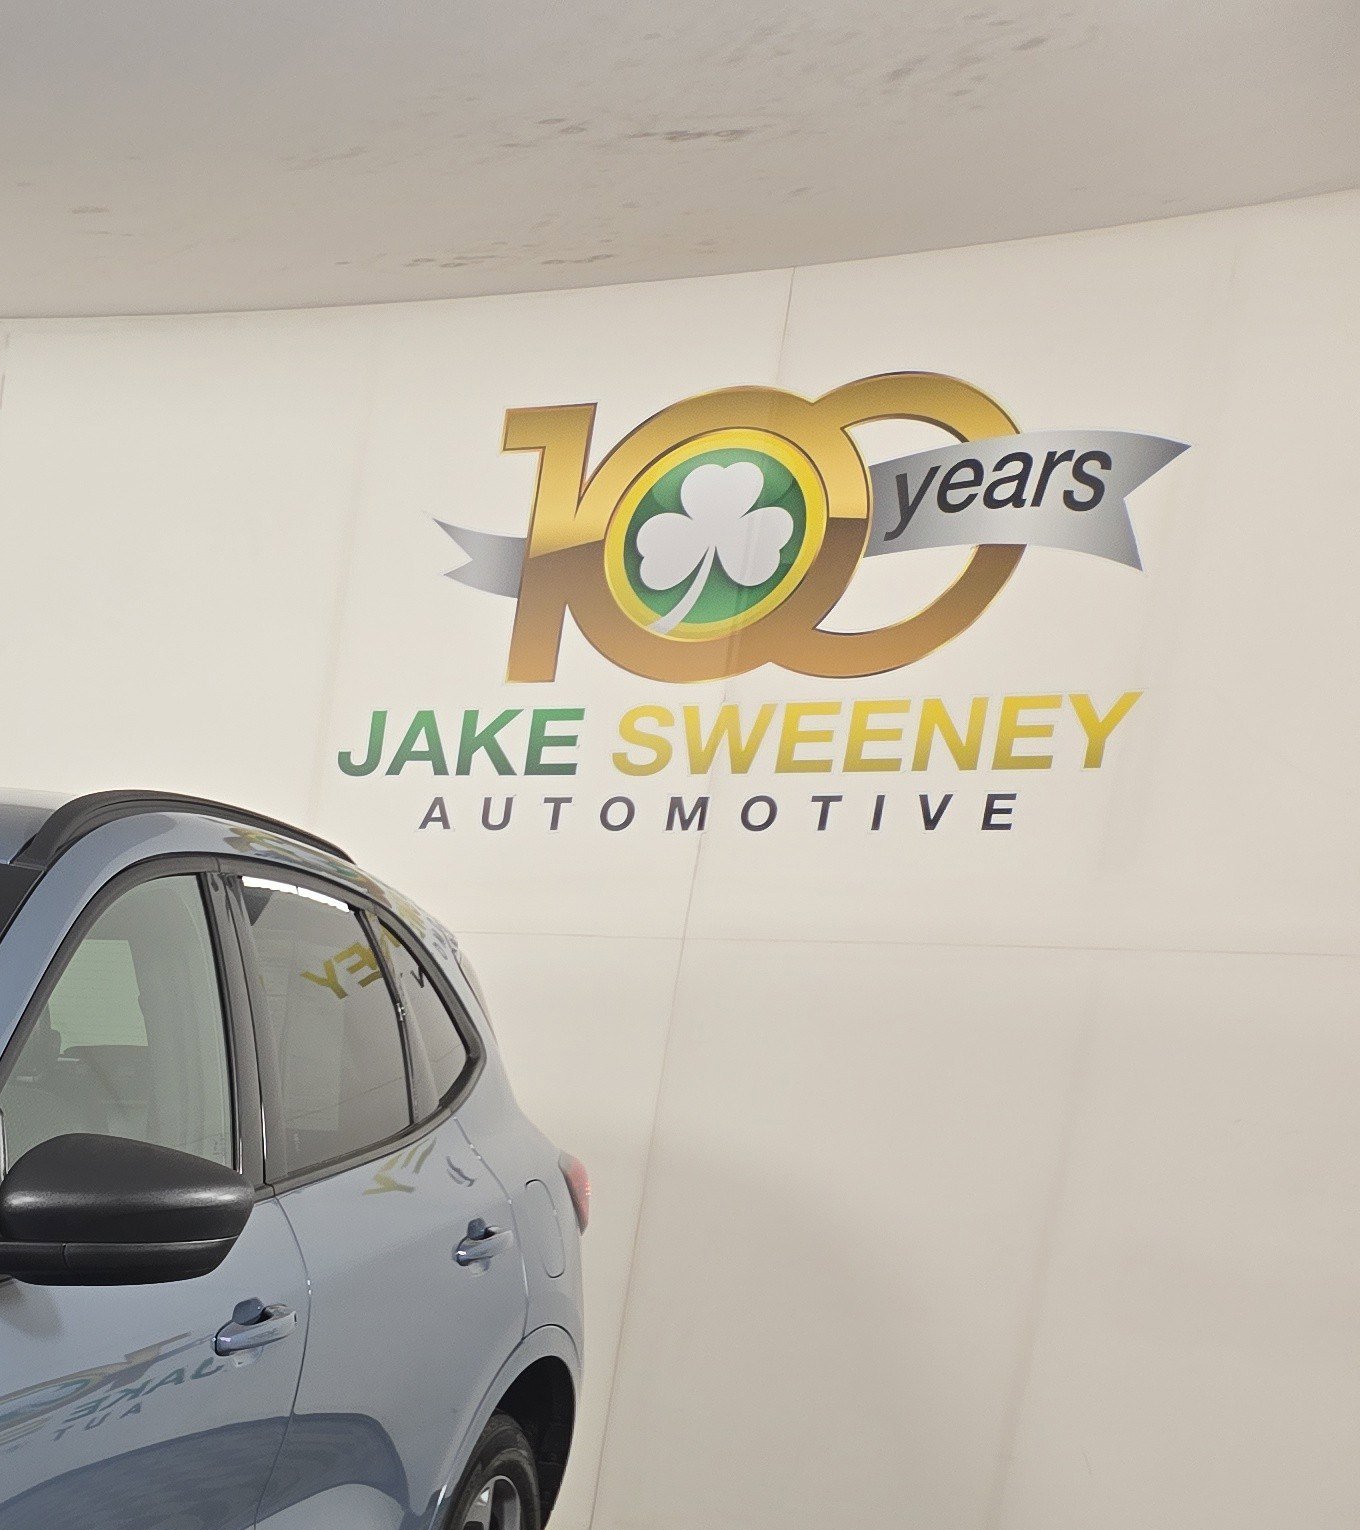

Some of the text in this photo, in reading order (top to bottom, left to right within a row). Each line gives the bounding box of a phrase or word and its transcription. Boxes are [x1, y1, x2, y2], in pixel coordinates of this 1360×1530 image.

[884, 448, 1112, 541] years
[337, 691, 1144, 777] JAKE SWEENEY
[419, 792, 1018, 833] AUTOMOTIVE
